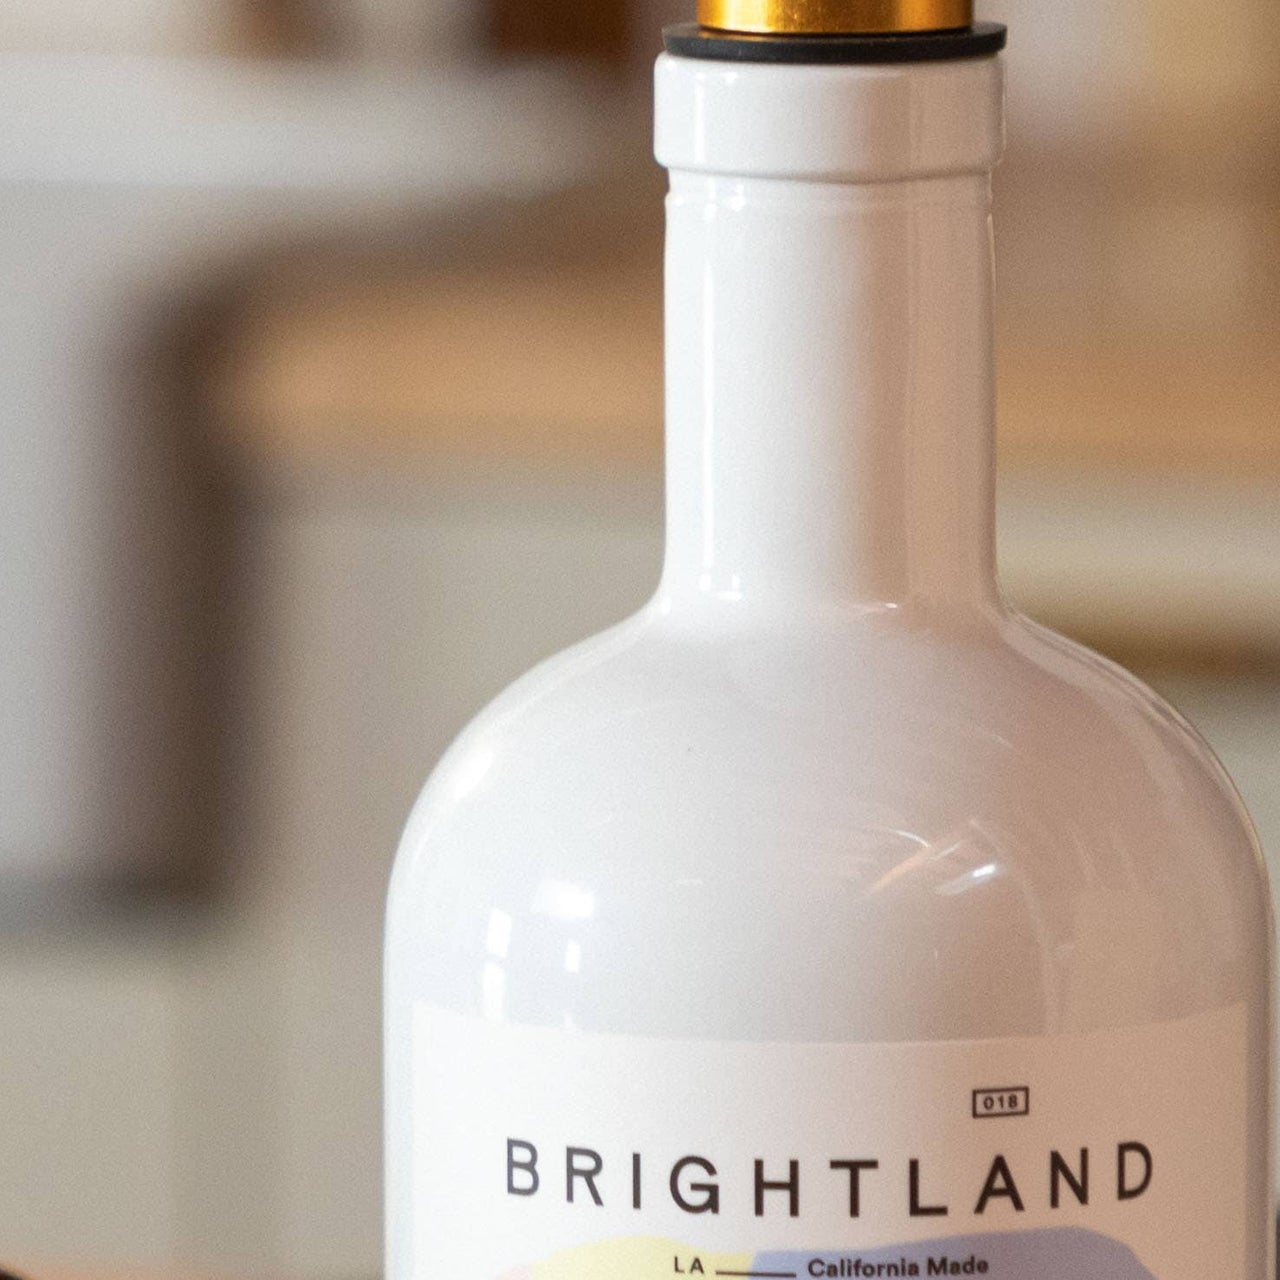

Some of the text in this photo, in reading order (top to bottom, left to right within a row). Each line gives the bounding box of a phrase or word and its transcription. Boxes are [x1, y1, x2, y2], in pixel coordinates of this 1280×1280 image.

[983, 1094, 1018, 1110] 018
[506, 1137, 1153, 1218] BRIGHTLAND
[674, 1255, 989, 1279] LA California Made
